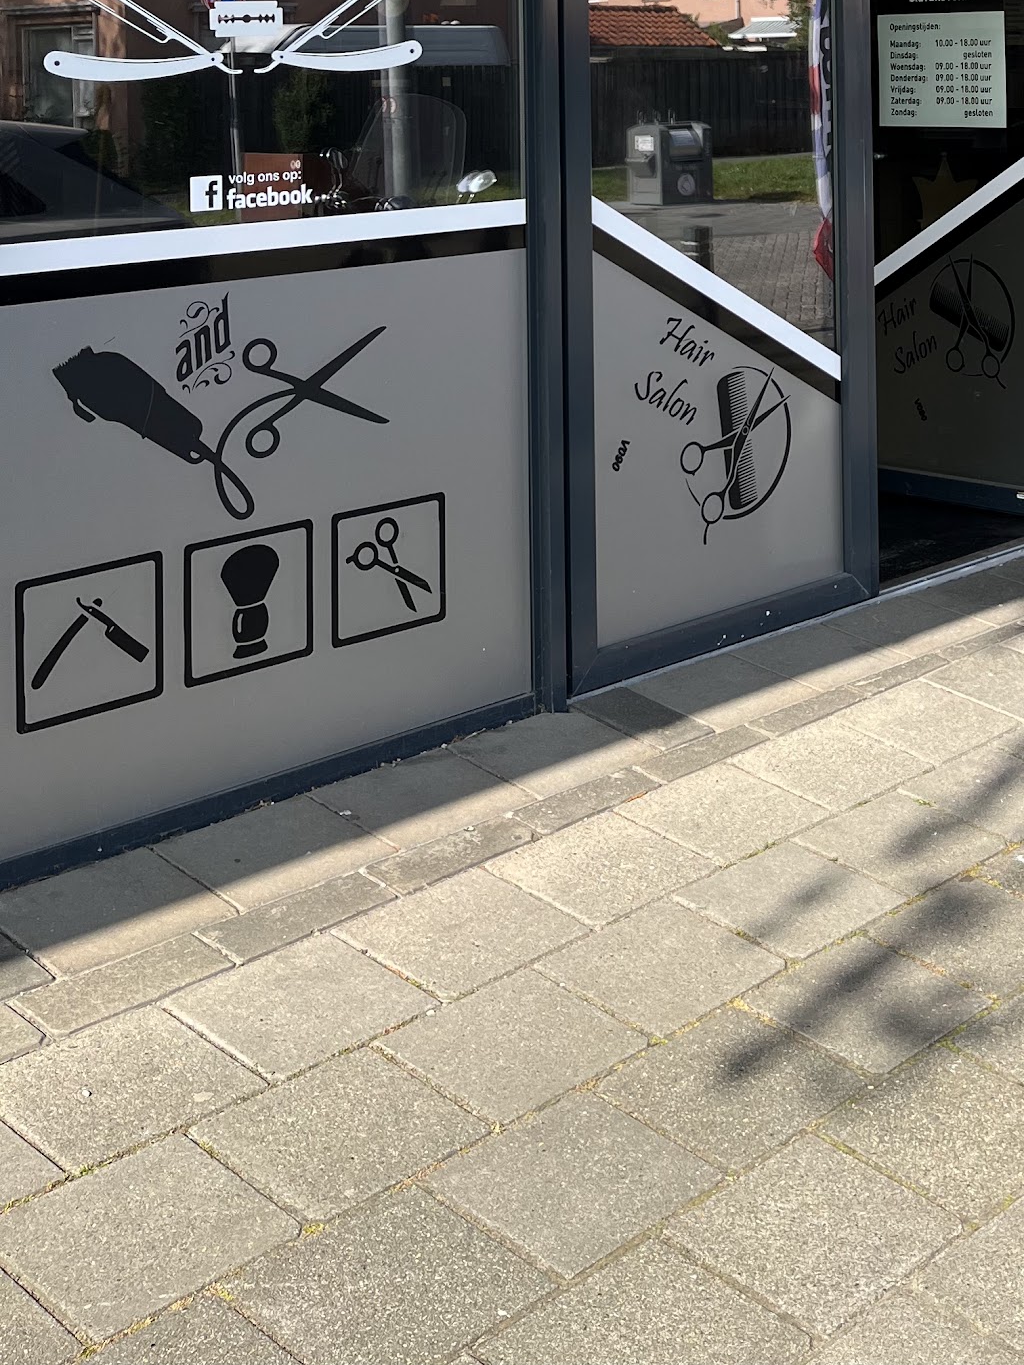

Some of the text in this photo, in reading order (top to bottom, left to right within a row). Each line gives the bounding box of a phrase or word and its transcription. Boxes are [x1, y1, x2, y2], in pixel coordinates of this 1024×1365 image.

[889, 23, 941, 32] Openingstijden:
[890, 40, 921, 49] Maandag:
[935, 39, 953, 47] 10.00
[960, 39, 978, 47] 18.00
[890, 50, 992, 60] Dinsdag: gesloten
[890, 63, 926, 72] Woensdag:
[935, 62, 954, 70] 09.00
[960, 62, 979, 70] 18.00
[890, 74, 928, 83] Donderdag:
[935, 74, 954, 82] 09.00
[890, 85, 916, 95] Vrijdag:
[935, 85, 954, 93] 09.00
[961, 85, 979, 93] 18.00
[890, 97, 922, 106] Zaterdag:
[936, 97, 955, 105] 09.00
[961, 97, 979, 105] 18.00
[980, 97, 993, 105] uur
[890, 108, 993, 118] Zondag: gesloten
[228, 170, 302, 185] volg ons op:
[226, 184, 314, 210] facebook
[877, 297, 917, 336] Hair
[176, 291, 232, 383] and
[659, 317, 715, 367] Hair
[894, 330, 938, 374] Salon
[634, 371, 698, 426] Salon
